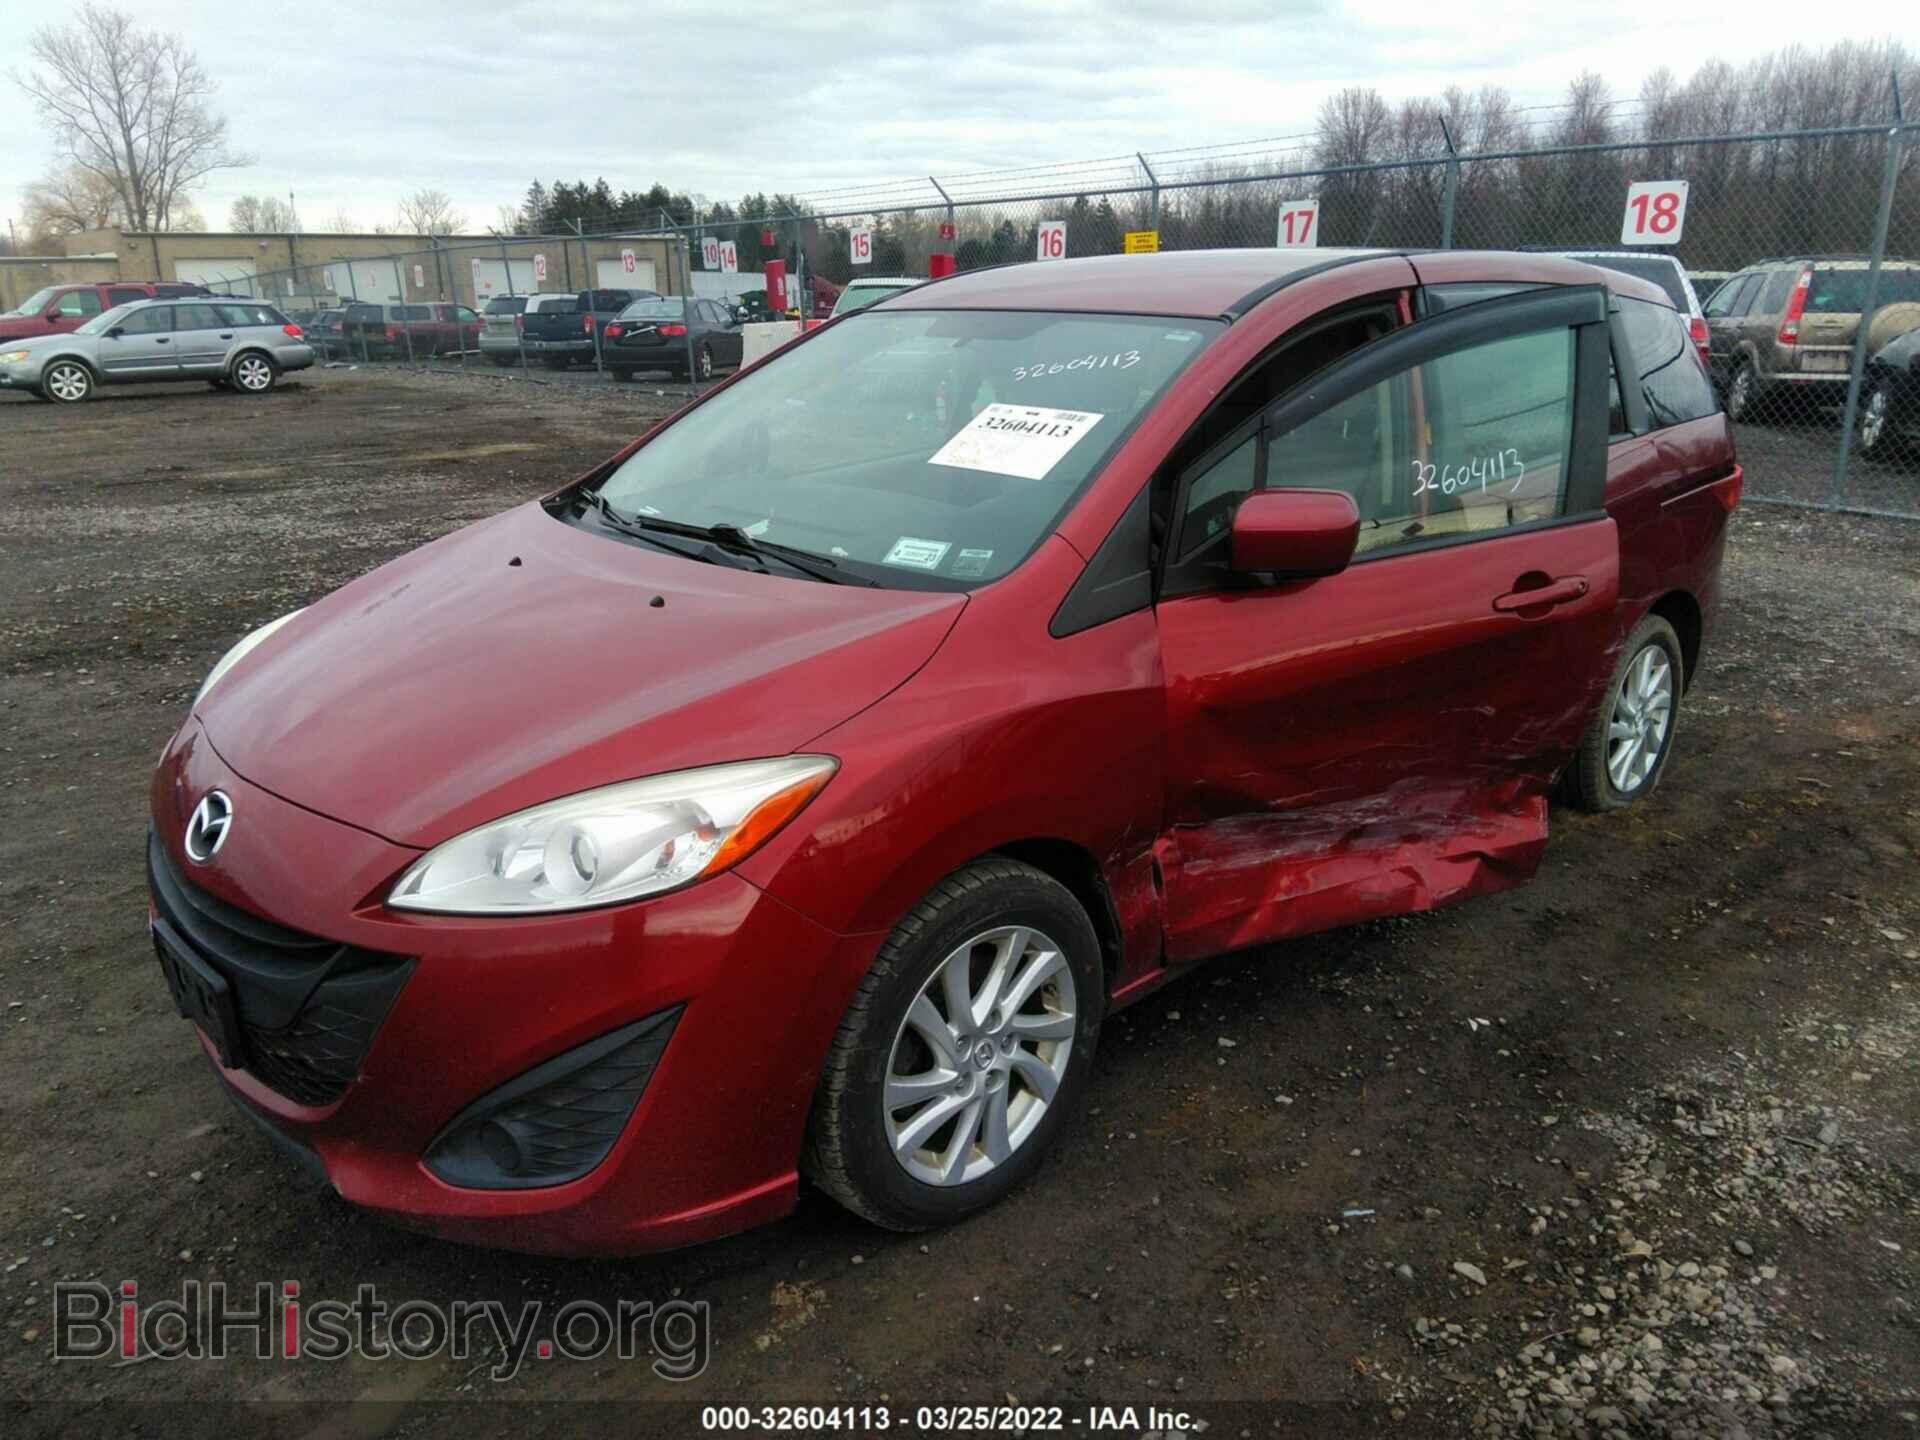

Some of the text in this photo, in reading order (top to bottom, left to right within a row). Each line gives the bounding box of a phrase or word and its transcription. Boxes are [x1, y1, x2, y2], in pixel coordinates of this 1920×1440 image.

[1282, 210, 1314, 244] 17
[1630, 192, 1680, 235] 18
[704, 244, 717, 263] 10
[853, 233, 869, 257] 15
[1040, 229, 1063, 257] 16
[623, 254, 635, 273] 13
[720, 247, 736, 268] 14
[1012, 350, 1140, 381] 32604113
[978, 412, 1073, 438] 32604113
[1411, 448, 1525, 497] 32604113
